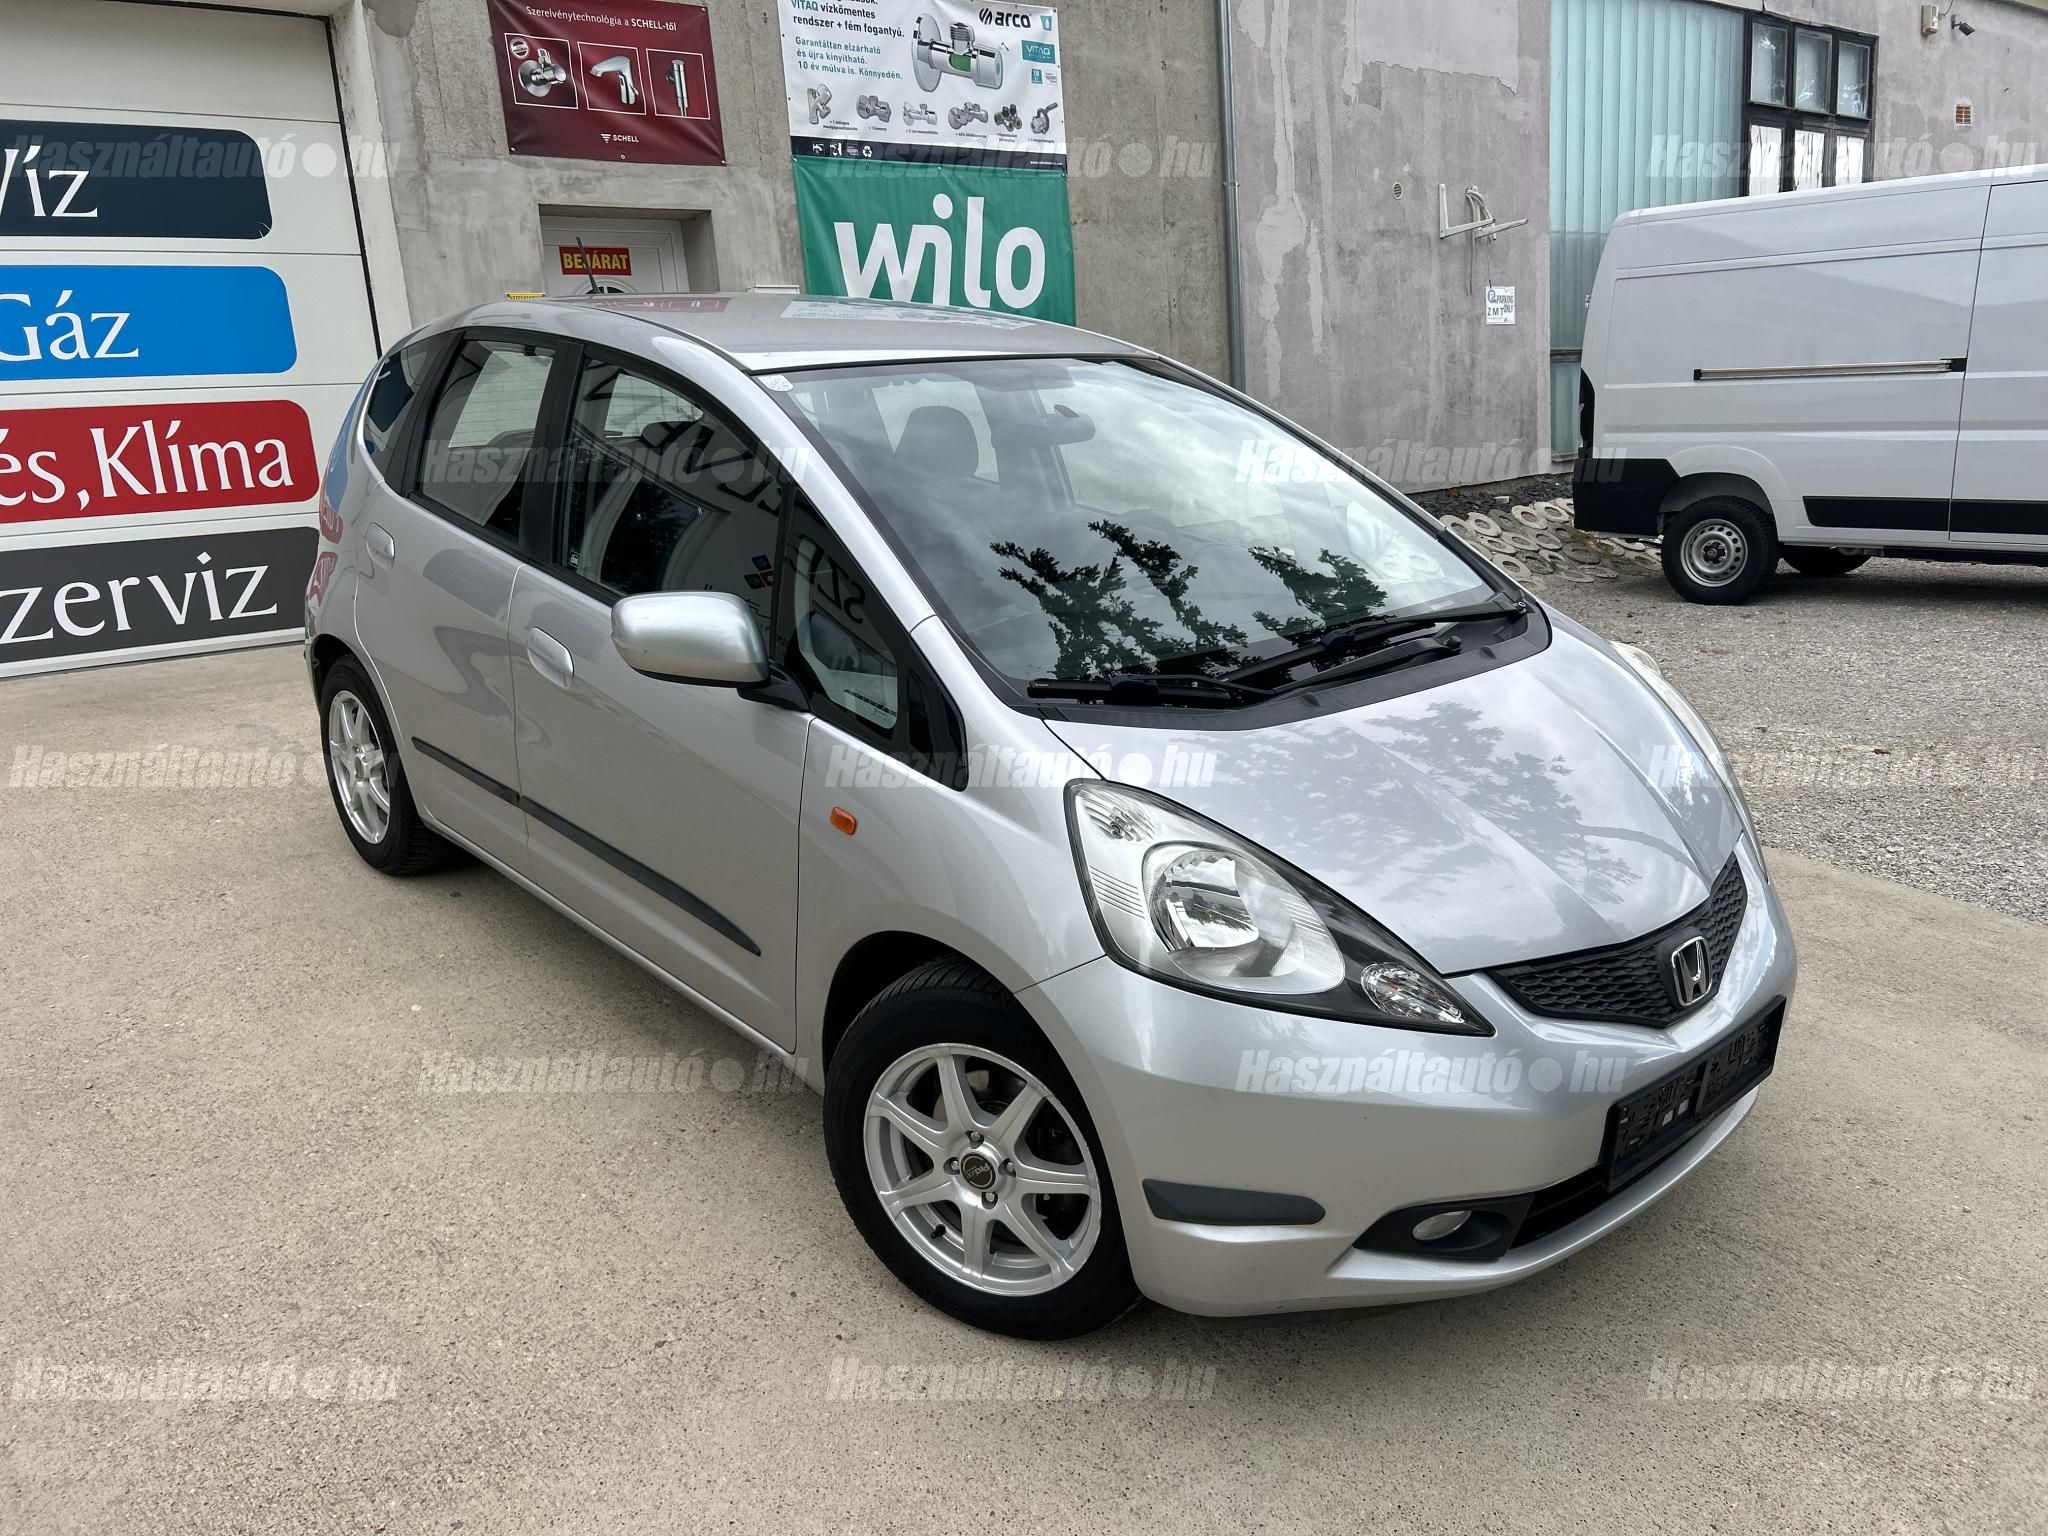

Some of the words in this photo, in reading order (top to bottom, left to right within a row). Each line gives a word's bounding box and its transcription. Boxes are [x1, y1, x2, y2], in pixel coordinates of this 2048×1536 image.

[526, 6, 623, 27] Szerelvénytechnológia
[793, 15, 834, 28] rendszer
[845, 20, 862, 32] fém
[995, 11, 1031, 28] arco
[795, 36, 842, 50] Garantáltan
[844, 43, 881, 55] elzárható
[797, 49, 806, 58] és
[808, 50, 824, 62] újra
[799, 60, 808, 70] 10
[810, 63, 820, 71] év
[821, 63, 846, 74] múlva
[613, 134, 639, 142] SCHELL
[834, 193, 1045, 309] wilo
